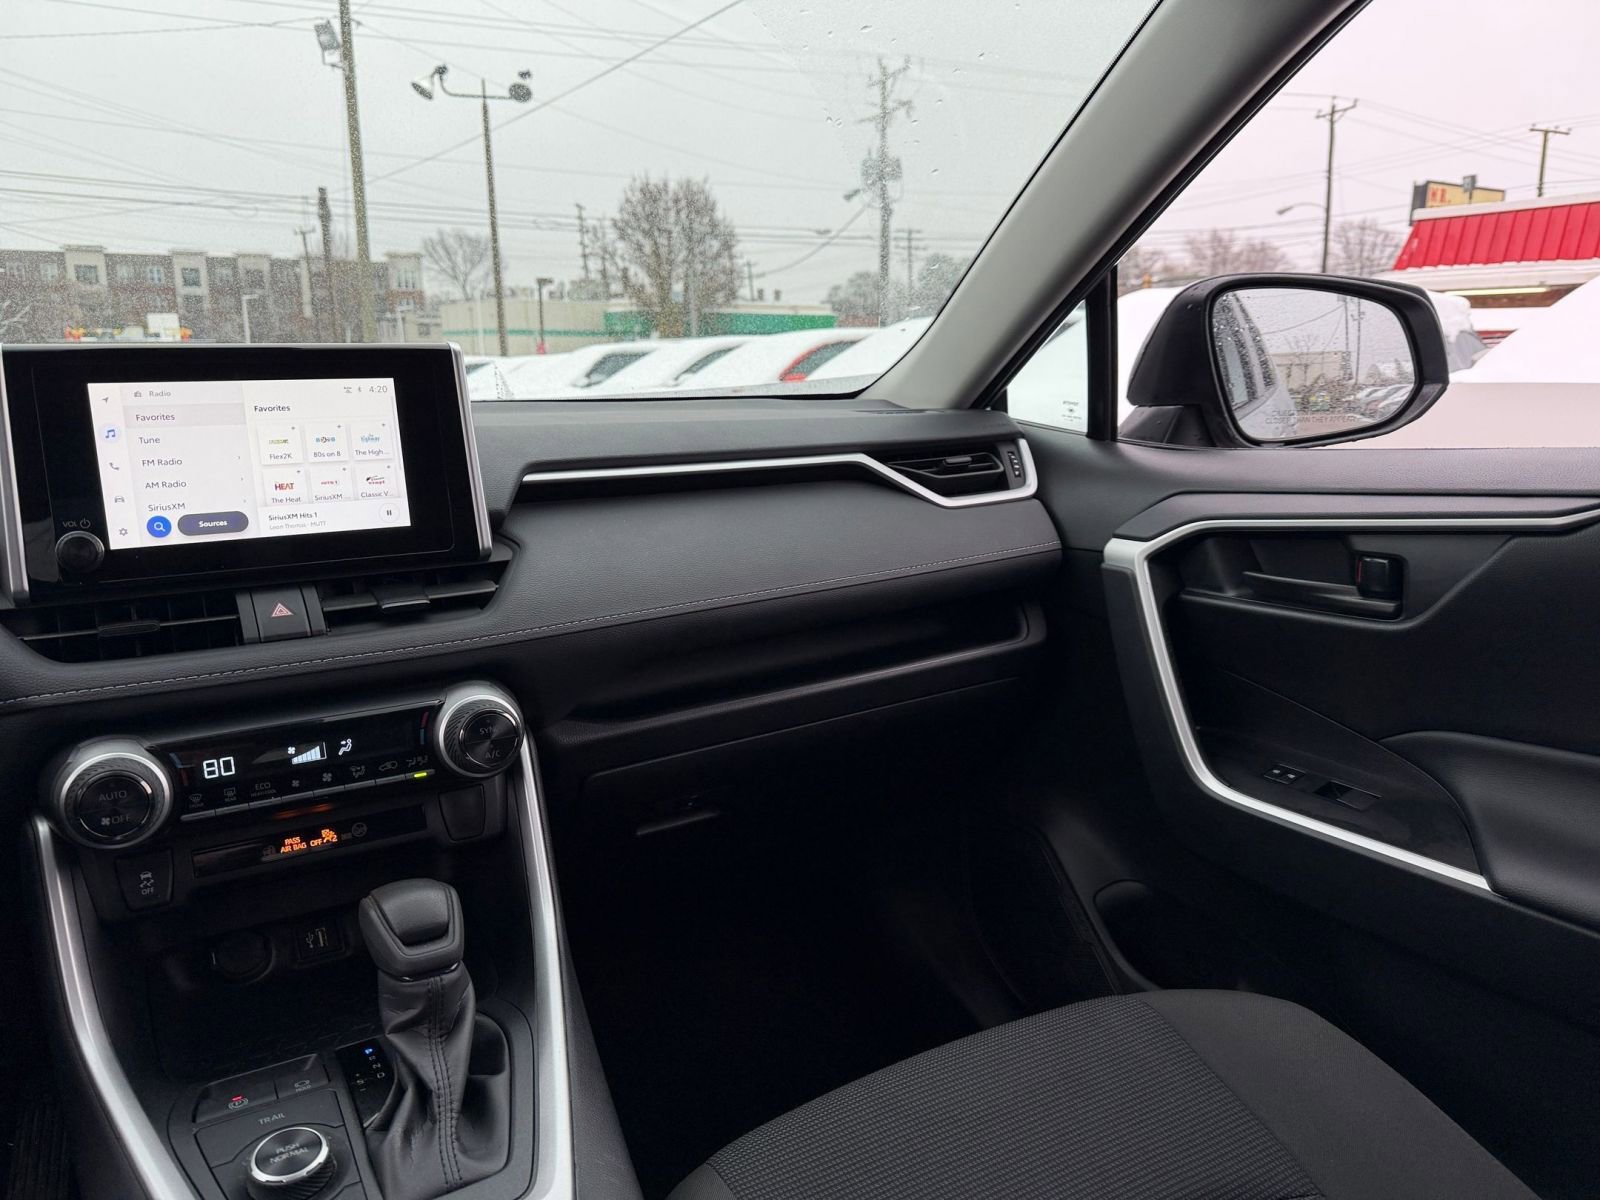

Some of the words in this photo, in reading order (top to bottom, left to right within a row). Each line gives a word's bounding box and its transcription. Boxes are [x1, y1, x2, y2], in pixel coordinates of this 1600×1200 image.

[368, 385, 388, 393] 4:20
[254, 404, 291, 412] Favorites
[135, 413, 176, 421] Favorites
[139, 436, 161, 444] Tune
[142, 459, 155, 467] FM
[157, 457, 183, 466] Radio
[145, 481, 160, 489] AM
[161, 479, 187, 488] Radio
[274, 482, 295, 491] HEAT
[314, 493, 343, 502] SiriusXM
[360, 489, 382, 498] Classic
[285, 496, 302, 504] Heat
[148, 502, 186, 512] SiriusXM
[268, 513, 299, 522] SiriusXM
[299, 511, 314, 519] Hits
[198, 519, 228, 528] Sources
[485, 749, 501, 759] A/C
[203, 756, 236, 779] 80
[255, 782, 271, 791] ECO
[99, 790, 127, 801] AUTO
[111, 814, 130, 824] OFF
[280, 845, 293, 853] AIR
[292, 842, 308, 851] BAG
[309, 838, 323, 848] OFF
[284, 836, 301, 846] PASS
[141, 887, 154, 896] OFF
[258, 1112, 286, 1125] TRAIL
[275, 1142, 300, 1154] PUSH
[269, 1146, 309, 1164] NORMAL
